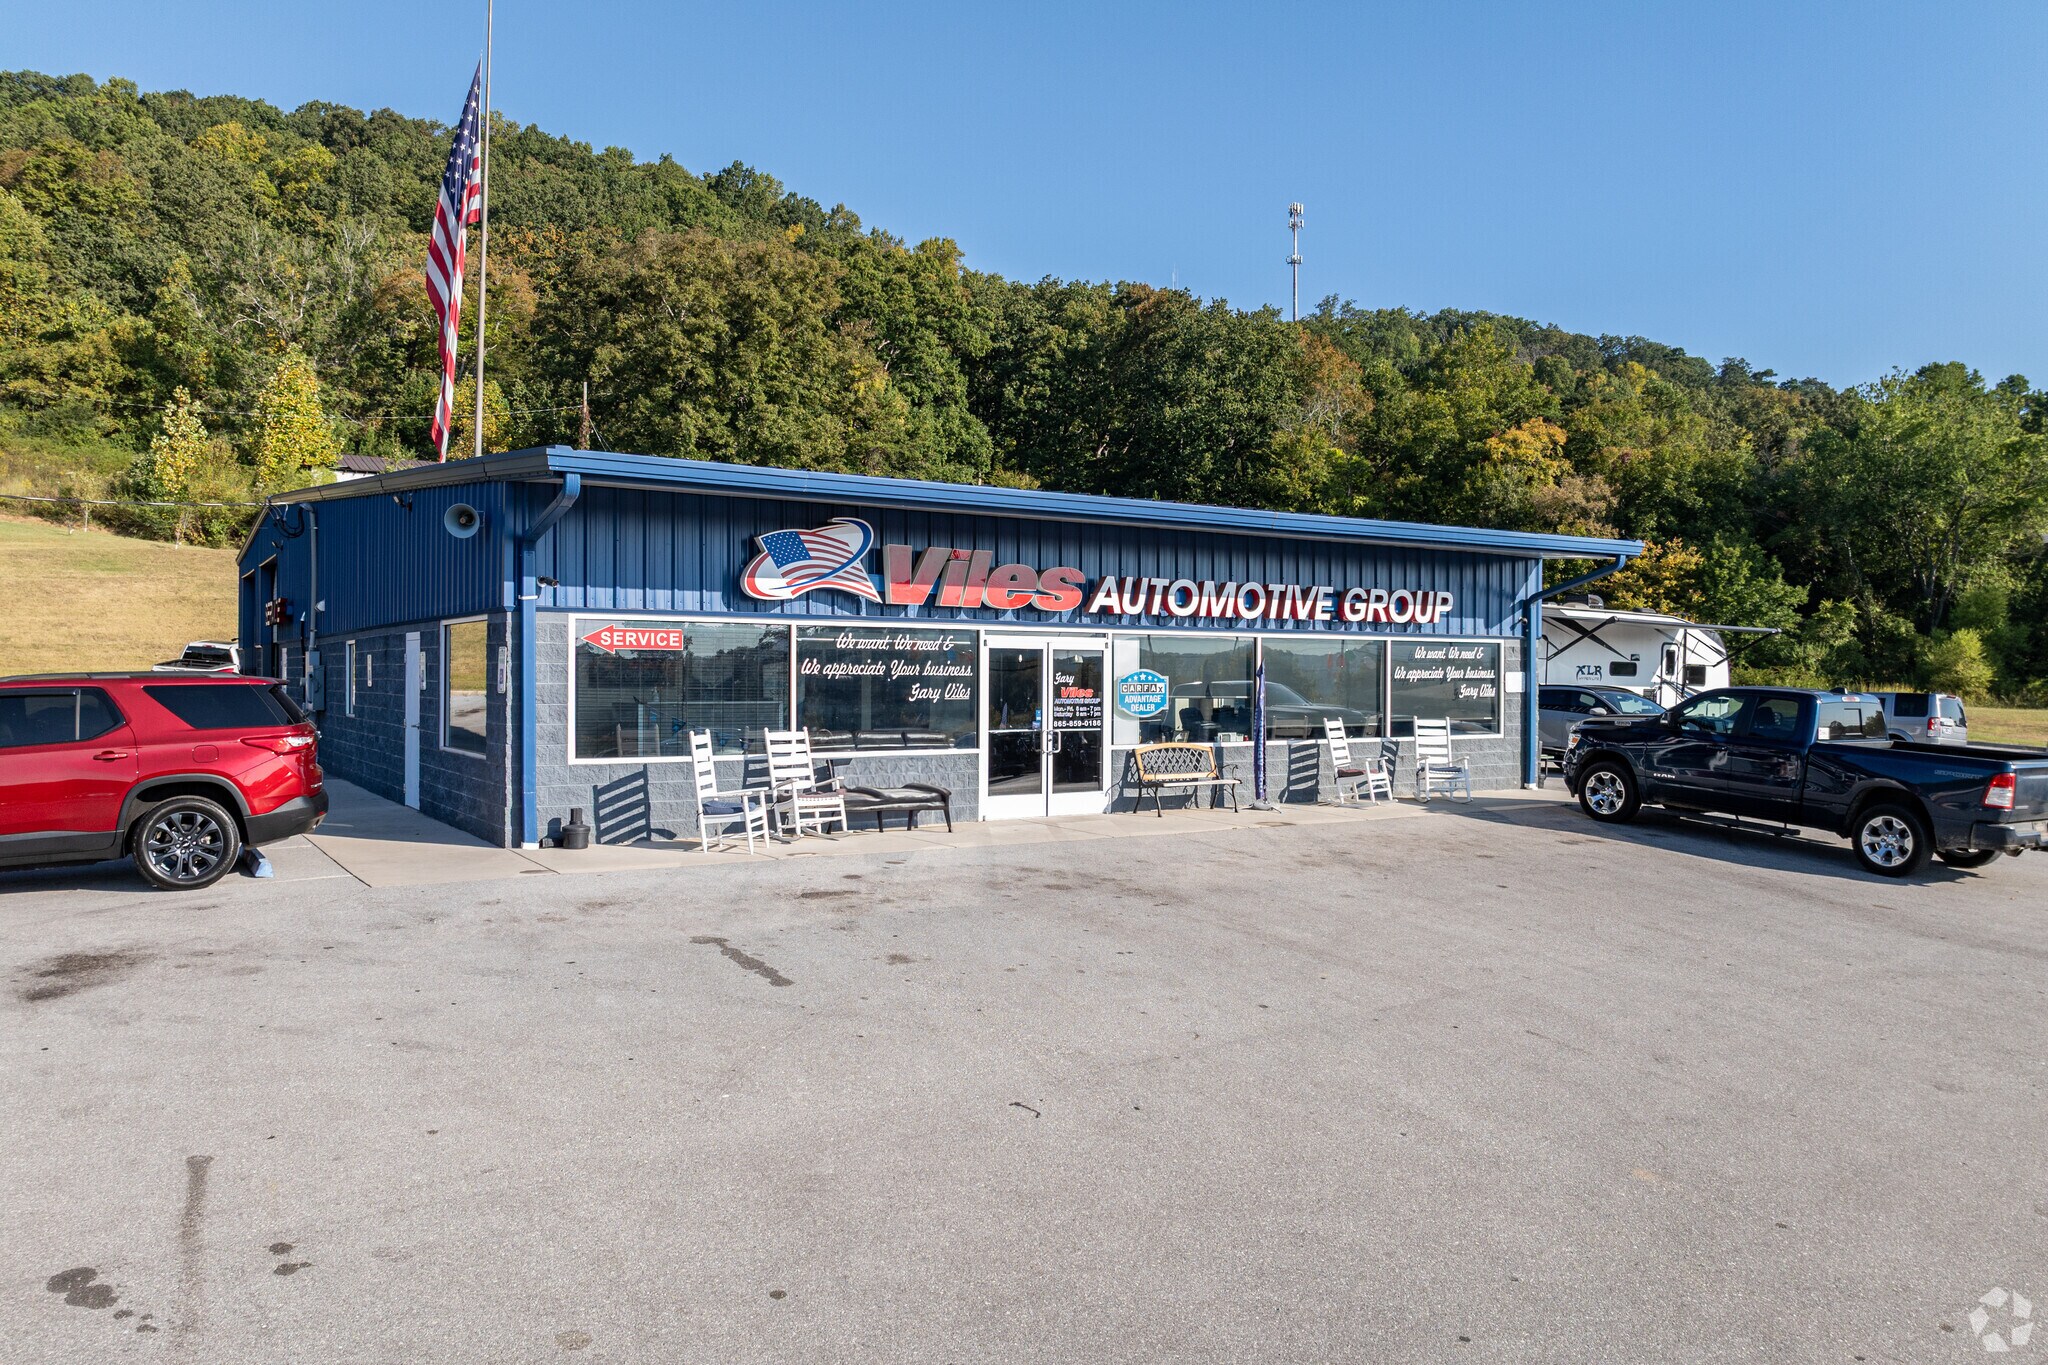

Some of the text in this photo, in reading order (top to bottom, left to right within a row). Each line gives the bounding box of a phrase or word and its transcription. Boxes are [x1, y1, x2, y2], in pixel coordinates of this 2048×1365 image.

[882, 544, 1454, 624] Viles AUTOMOTIVE GROUP
[600, 631, 680, 646] SERVICE
[836, 633, 855, 649] We
[894, 634, 912, 650] We
[913, 636, 941, 650] need
[942, 635, 954, 650] &
[1415, 646, 1425, 659] We
[1448, 646, 1459, 659] We
[1459, 647, 1477, 659] need
[801, 658, 973, 679] We appreciate Your business.
[1394, 666, 1406, 679] We
[1406, 666, 1444, 682] appreciate
[1446, 666, 1464, 682] Your
[1576, 664, 1602, 681] XLR
[1054, 672, 1074, 686] Gary
[909, 683, 941, 703] Gary
[1061, 687, 1094, 697] Viles
[1459, 684, 1478, 699] Gary
